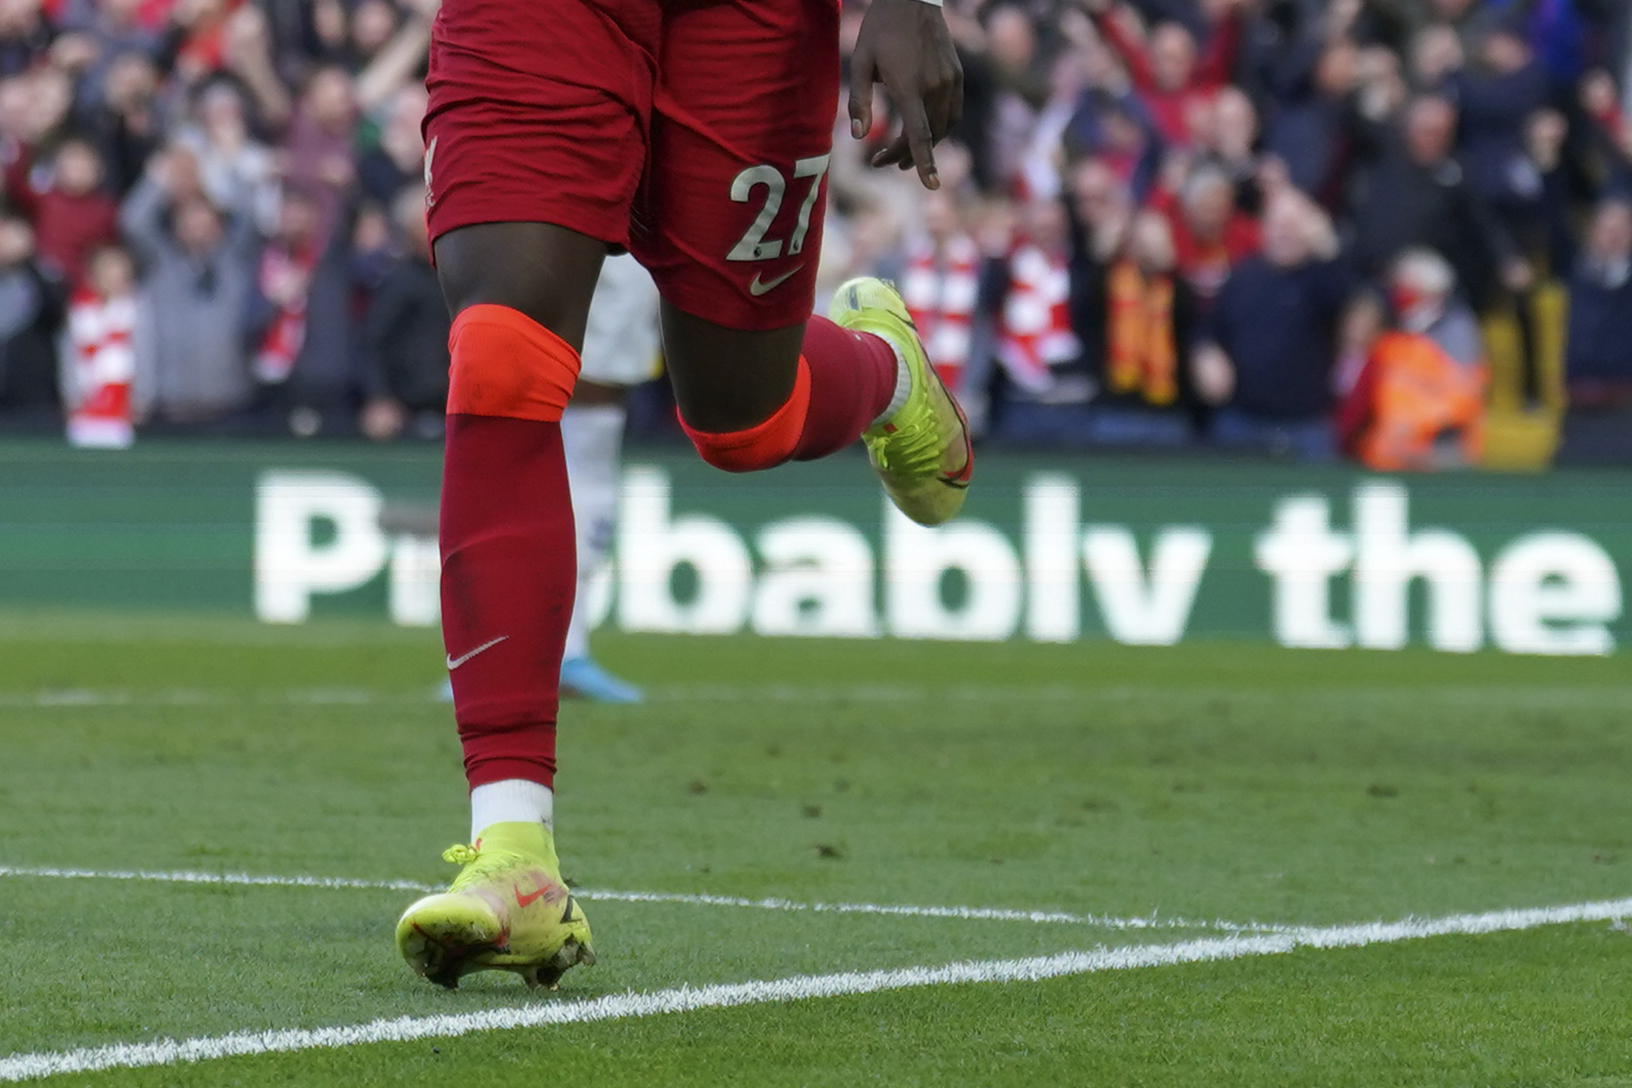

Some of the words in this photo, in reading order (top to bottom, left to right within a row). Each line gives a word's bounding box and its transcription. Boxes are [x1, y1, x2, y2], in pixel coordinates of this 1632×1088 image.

[725, 153, 830, 261] 27
[255, 468, 1216, 646] Prbably
[1256, 482, 1622, 656] the
